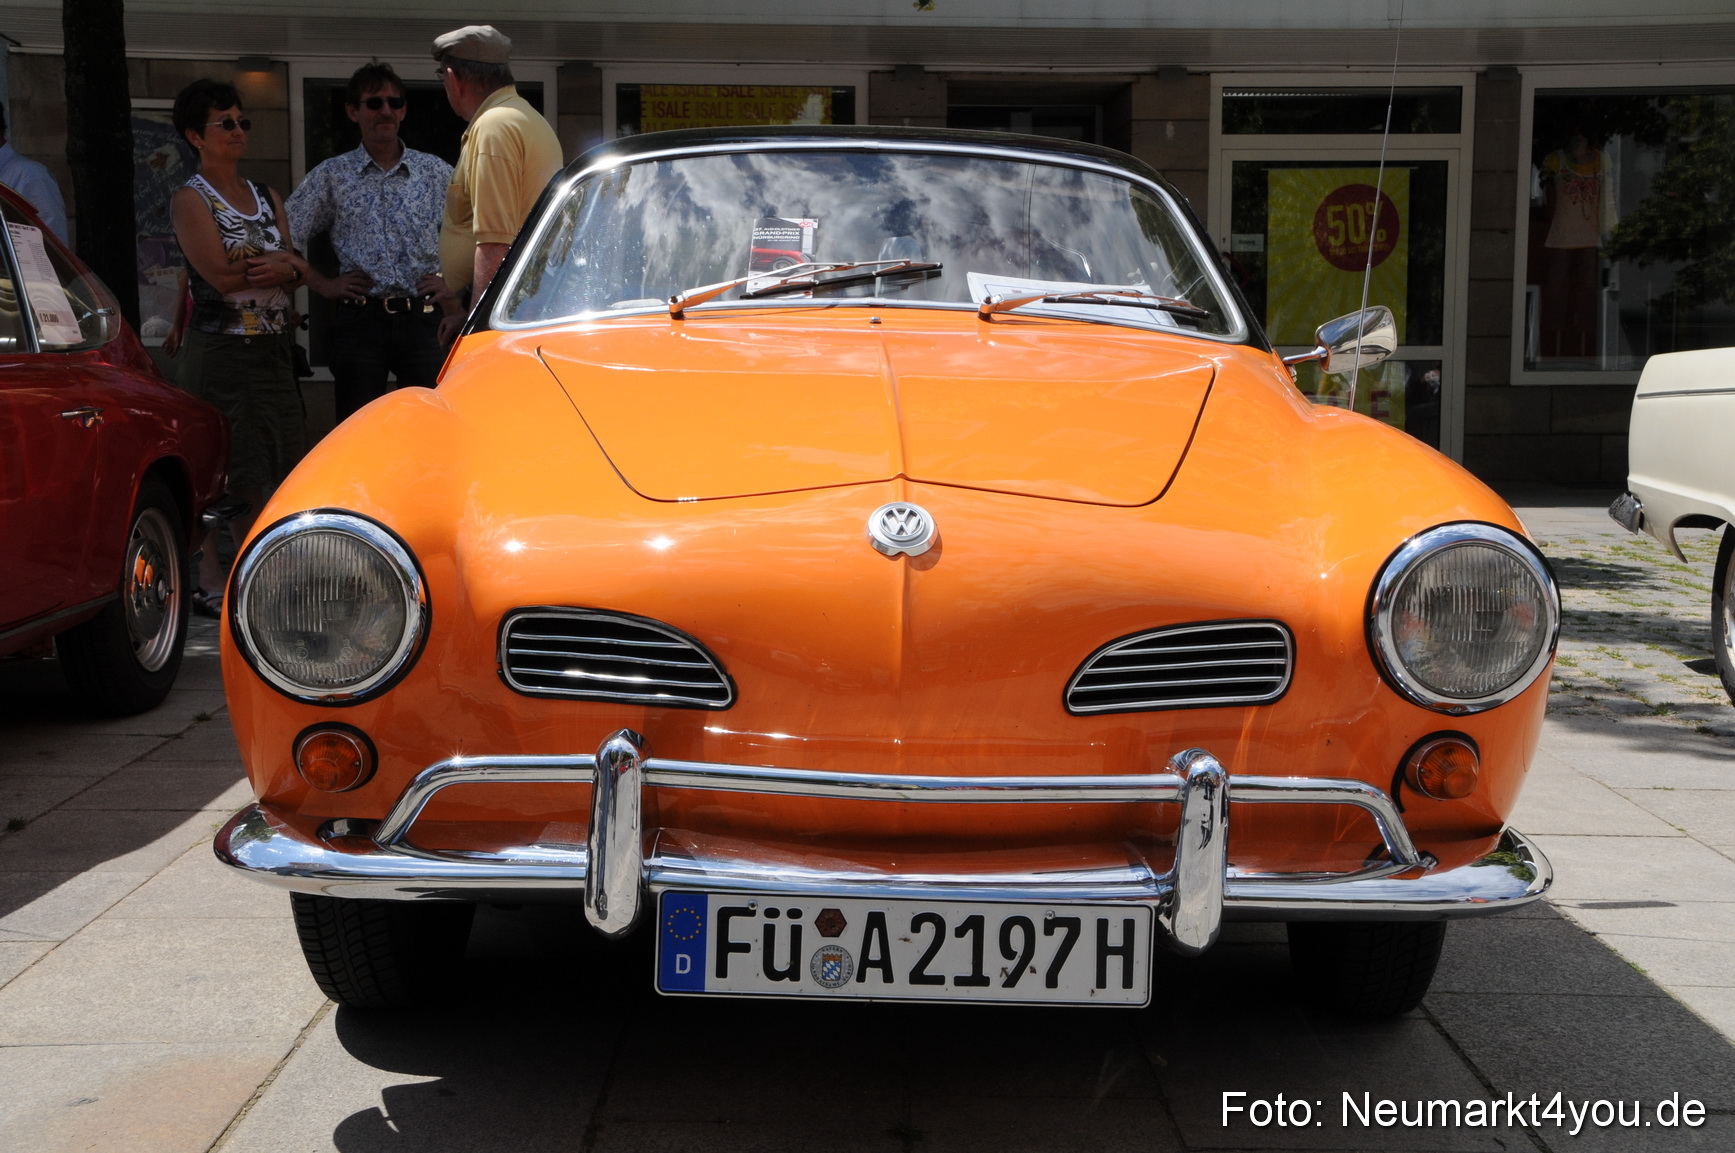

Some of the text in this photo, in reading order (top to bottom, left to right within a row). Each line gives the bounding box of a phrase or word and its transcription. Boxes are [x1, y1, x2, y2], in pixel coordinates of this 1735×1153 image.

[721, 86, 754, 98] SALE
[656, 101, 690, 119] SALE
[700, 102, 734, 119] SALE
[743, 102, 776, 120] SALE
[1327, 200, 1387, 247] 50%
[675, 953, 691, 974] D
